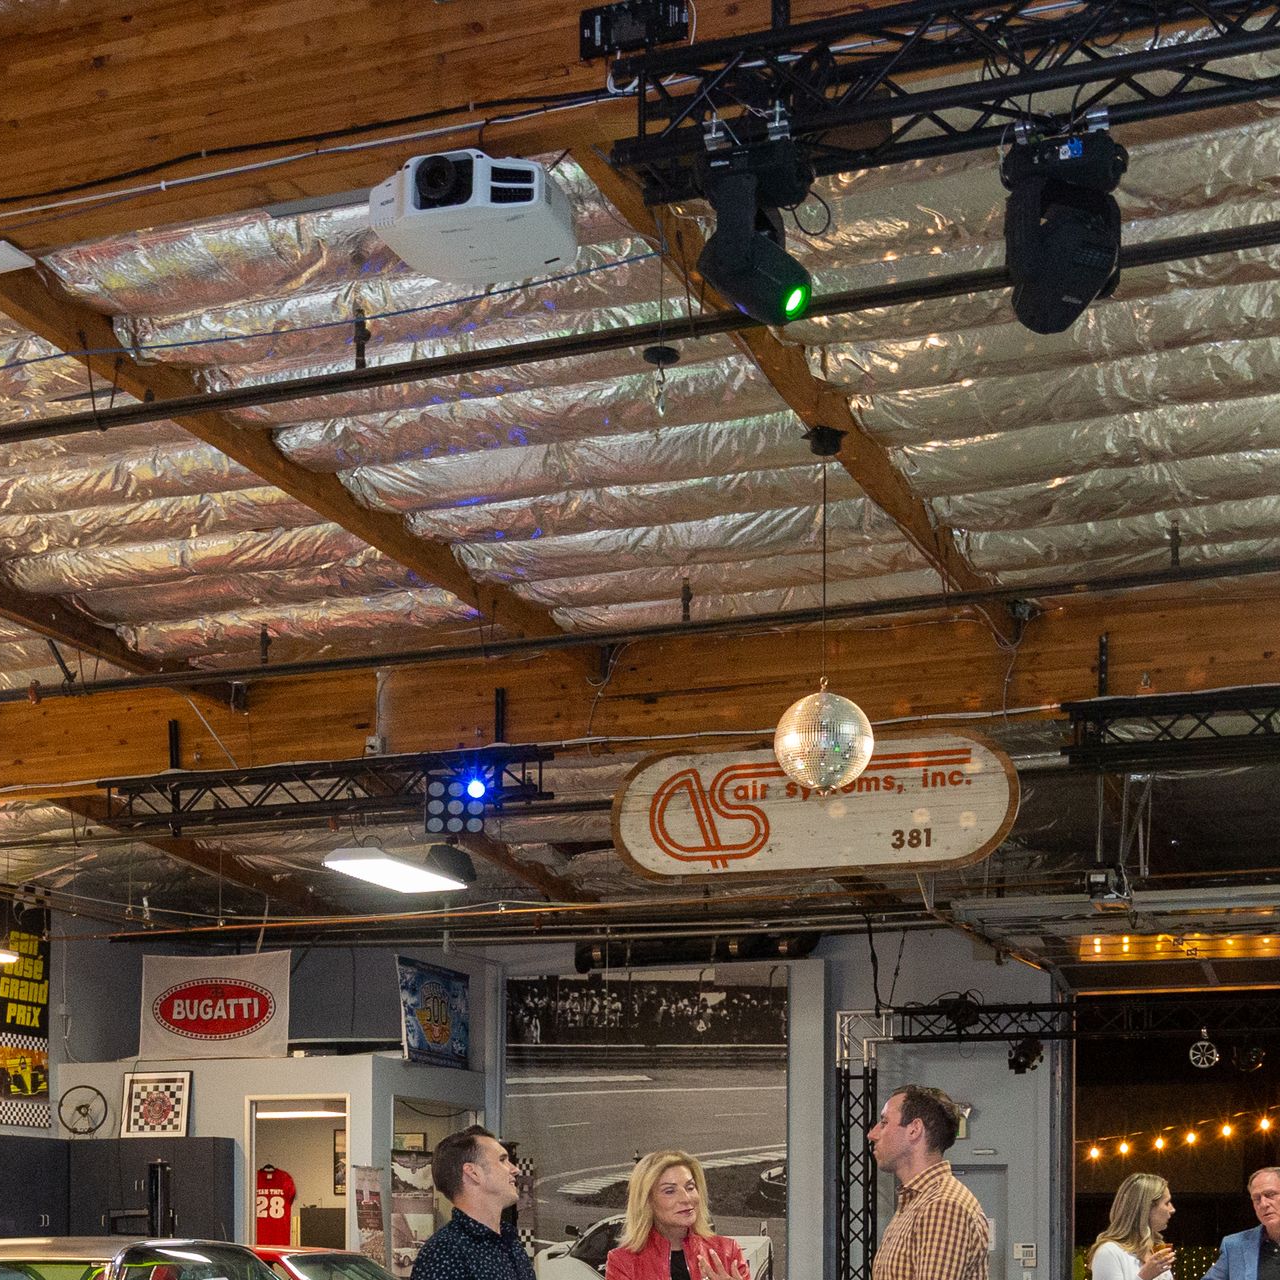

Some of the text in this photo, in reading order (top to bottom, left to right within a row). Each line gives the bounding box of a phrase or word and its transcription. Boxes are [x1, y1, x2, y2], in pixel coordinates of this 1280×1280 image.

[734, 768, 972, 801] air syems, inc.
[891, 828, 932, 849] 381
[172, 998, 259, 1020] BUGATTI
[424, 996, 448, 1025] 500
[256, 1196, 285, 1219] 28
